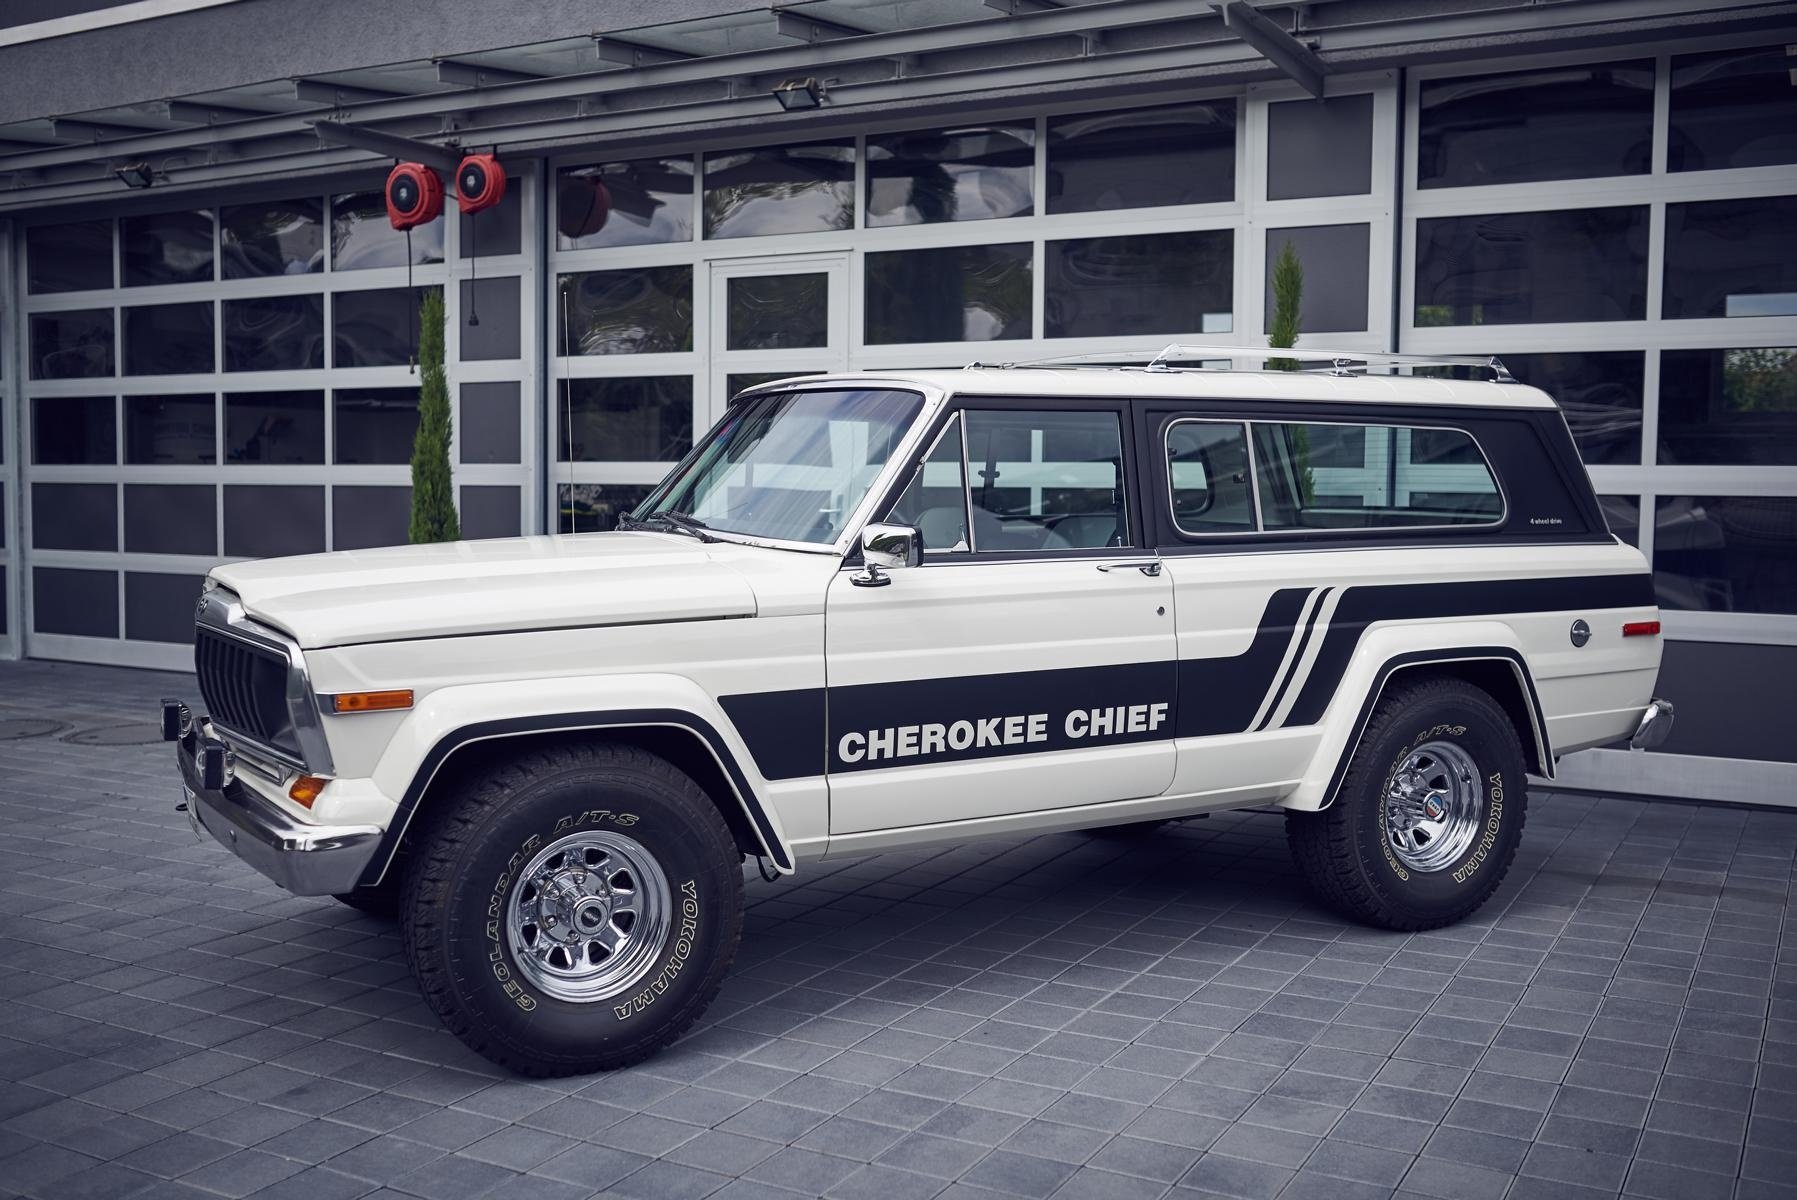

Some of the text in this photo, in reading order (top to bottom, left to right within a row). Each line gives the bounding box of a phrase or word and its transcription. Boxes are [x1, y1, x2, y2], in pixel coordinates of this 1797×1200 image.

[838, 702, 1169, 763] CHEROKEE CHIEF
[1453, 772, 1504, 883] YOKOHAMA
[487, 833, 541, 1012] GEOLANDAR
[614, 880, 699, 1020] YOKOHAMA
